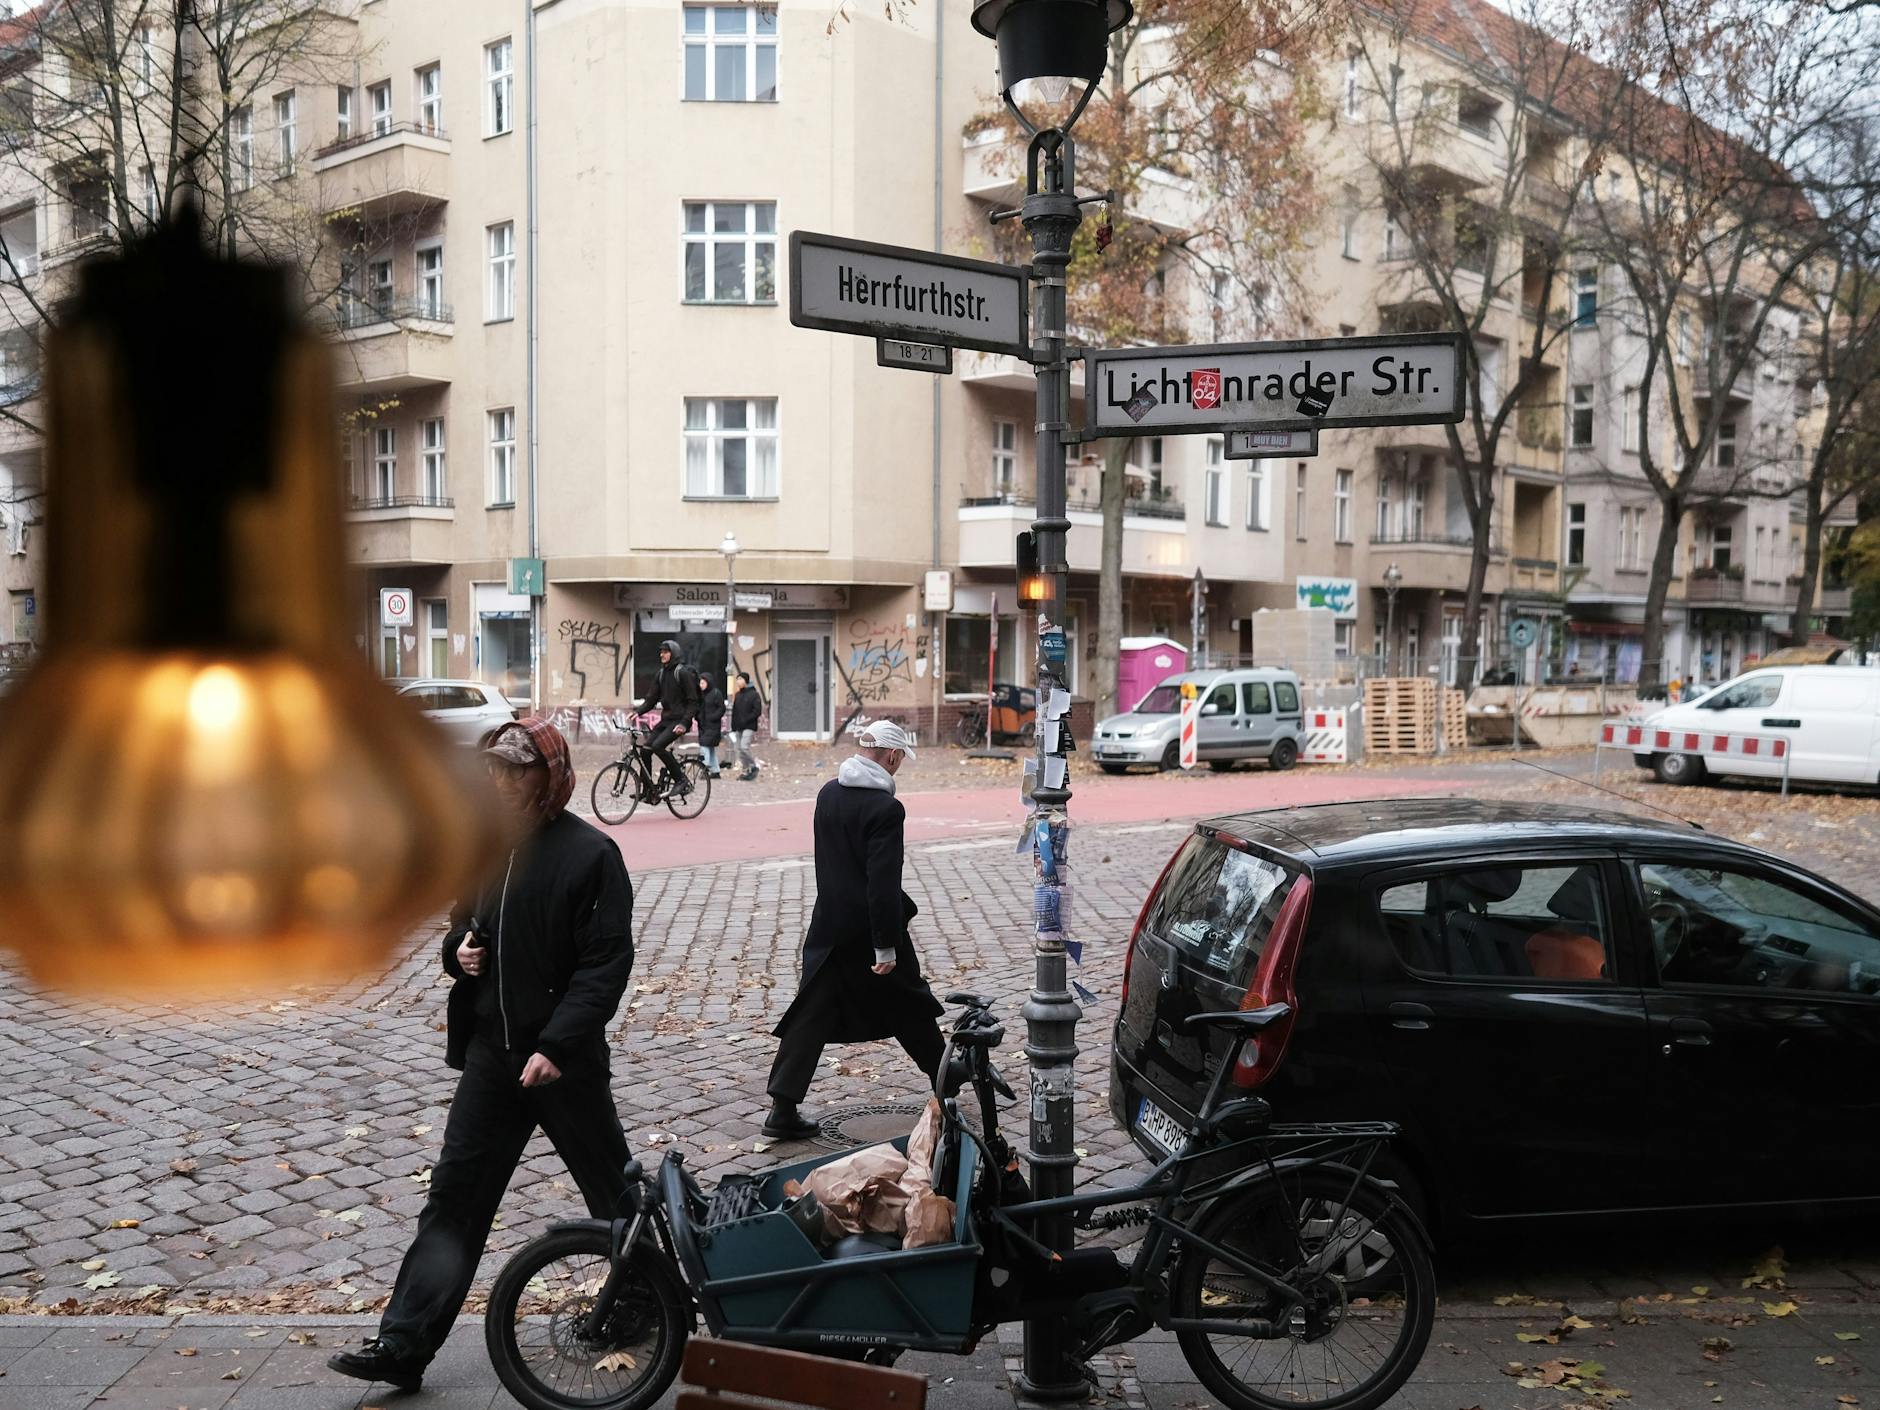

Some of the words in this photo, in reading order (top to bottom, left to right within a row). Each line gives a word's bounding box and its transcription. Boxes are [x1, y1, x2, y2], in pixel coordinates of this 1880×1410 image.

[838, 265, 990, 323] Herrfurthstr.
[900, 345, 912, 360] 18
[921, 347, 933, 362] 21
[1107, 360, 1355, 407] Lichtnrader
[1371, 355, 1440, 396] Str.
[392, 599, 403, 610] 30
[675, 586, 720, 601] Salon
[1142, 1101, 1151, 1124] B
[1151, 1109, 1166, 1136] HP
